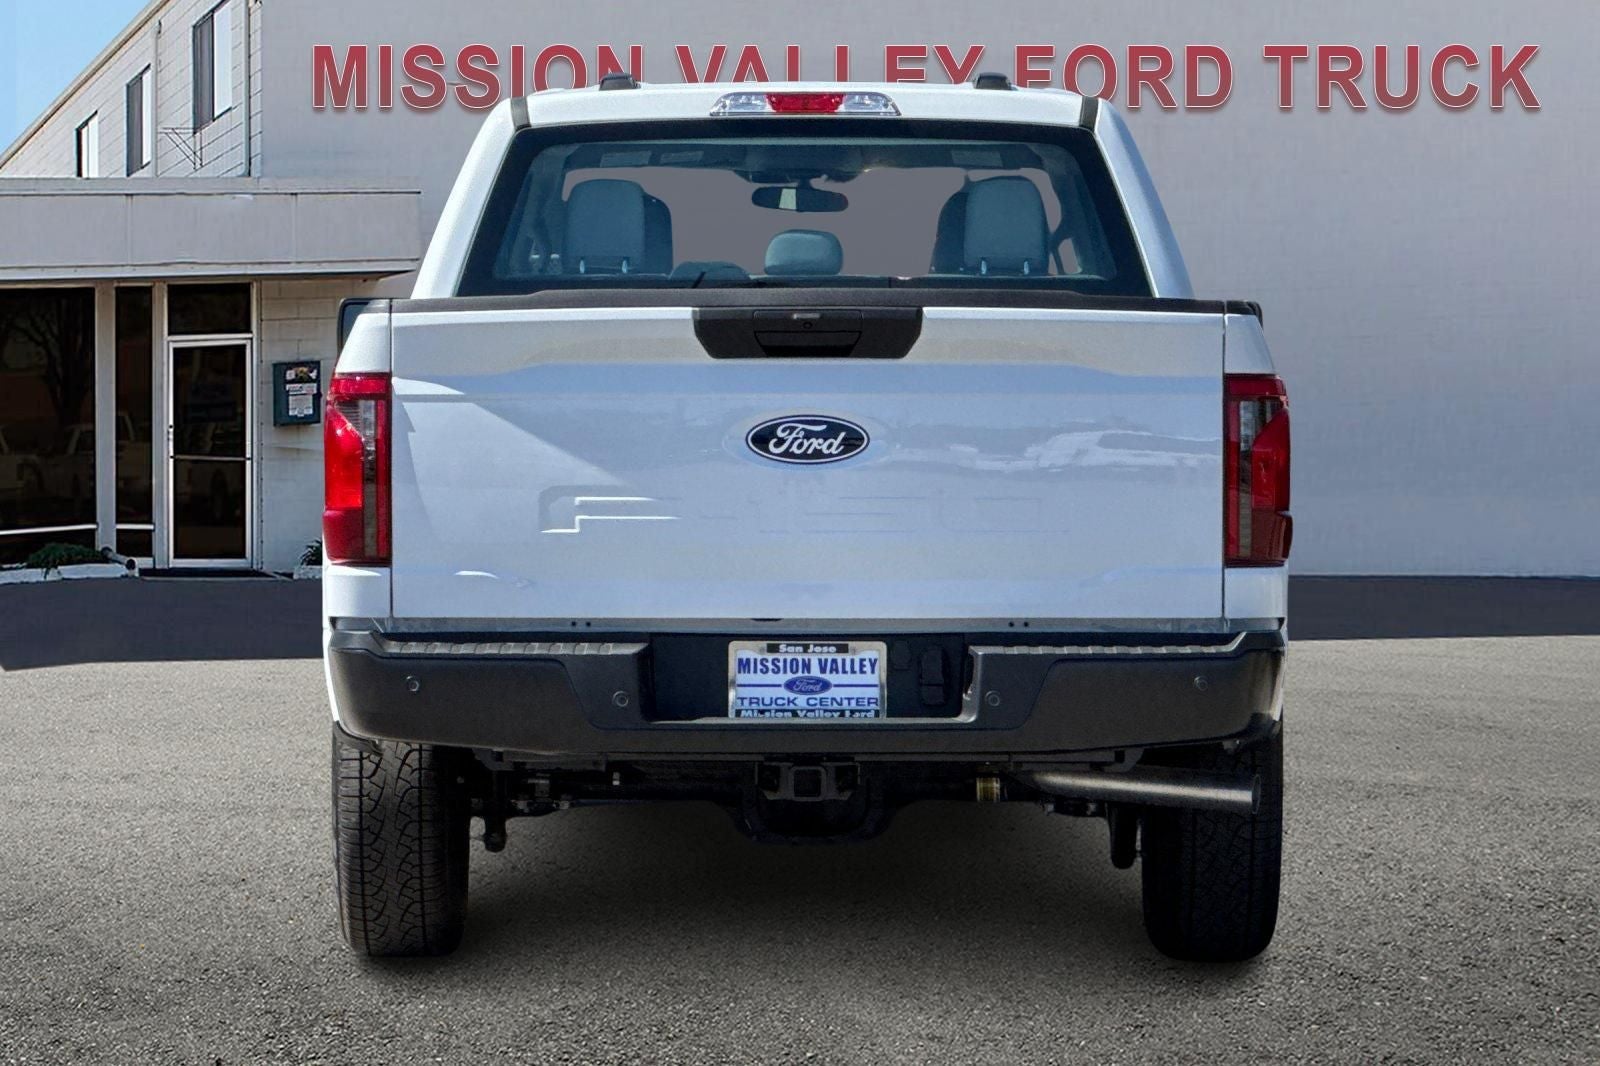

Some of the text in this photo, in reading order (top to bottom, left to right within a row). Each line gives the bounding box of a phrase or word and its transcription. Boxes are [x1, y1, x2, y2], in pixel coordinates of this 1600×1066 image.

[312, 44, 643, 109] MISSION
[1015, 44, 1233, 110] FORD
[1264, 44, 1541, 110] TRUCK
[768, 422, 847, 455] Ford
[779, 644, 837, 653] San Jose
[737, 658, 878, 675] MISSION VALLEY
[793, 679, 823, 692] Ford
[737, 697, 879, 707] TRUCK CENTER
